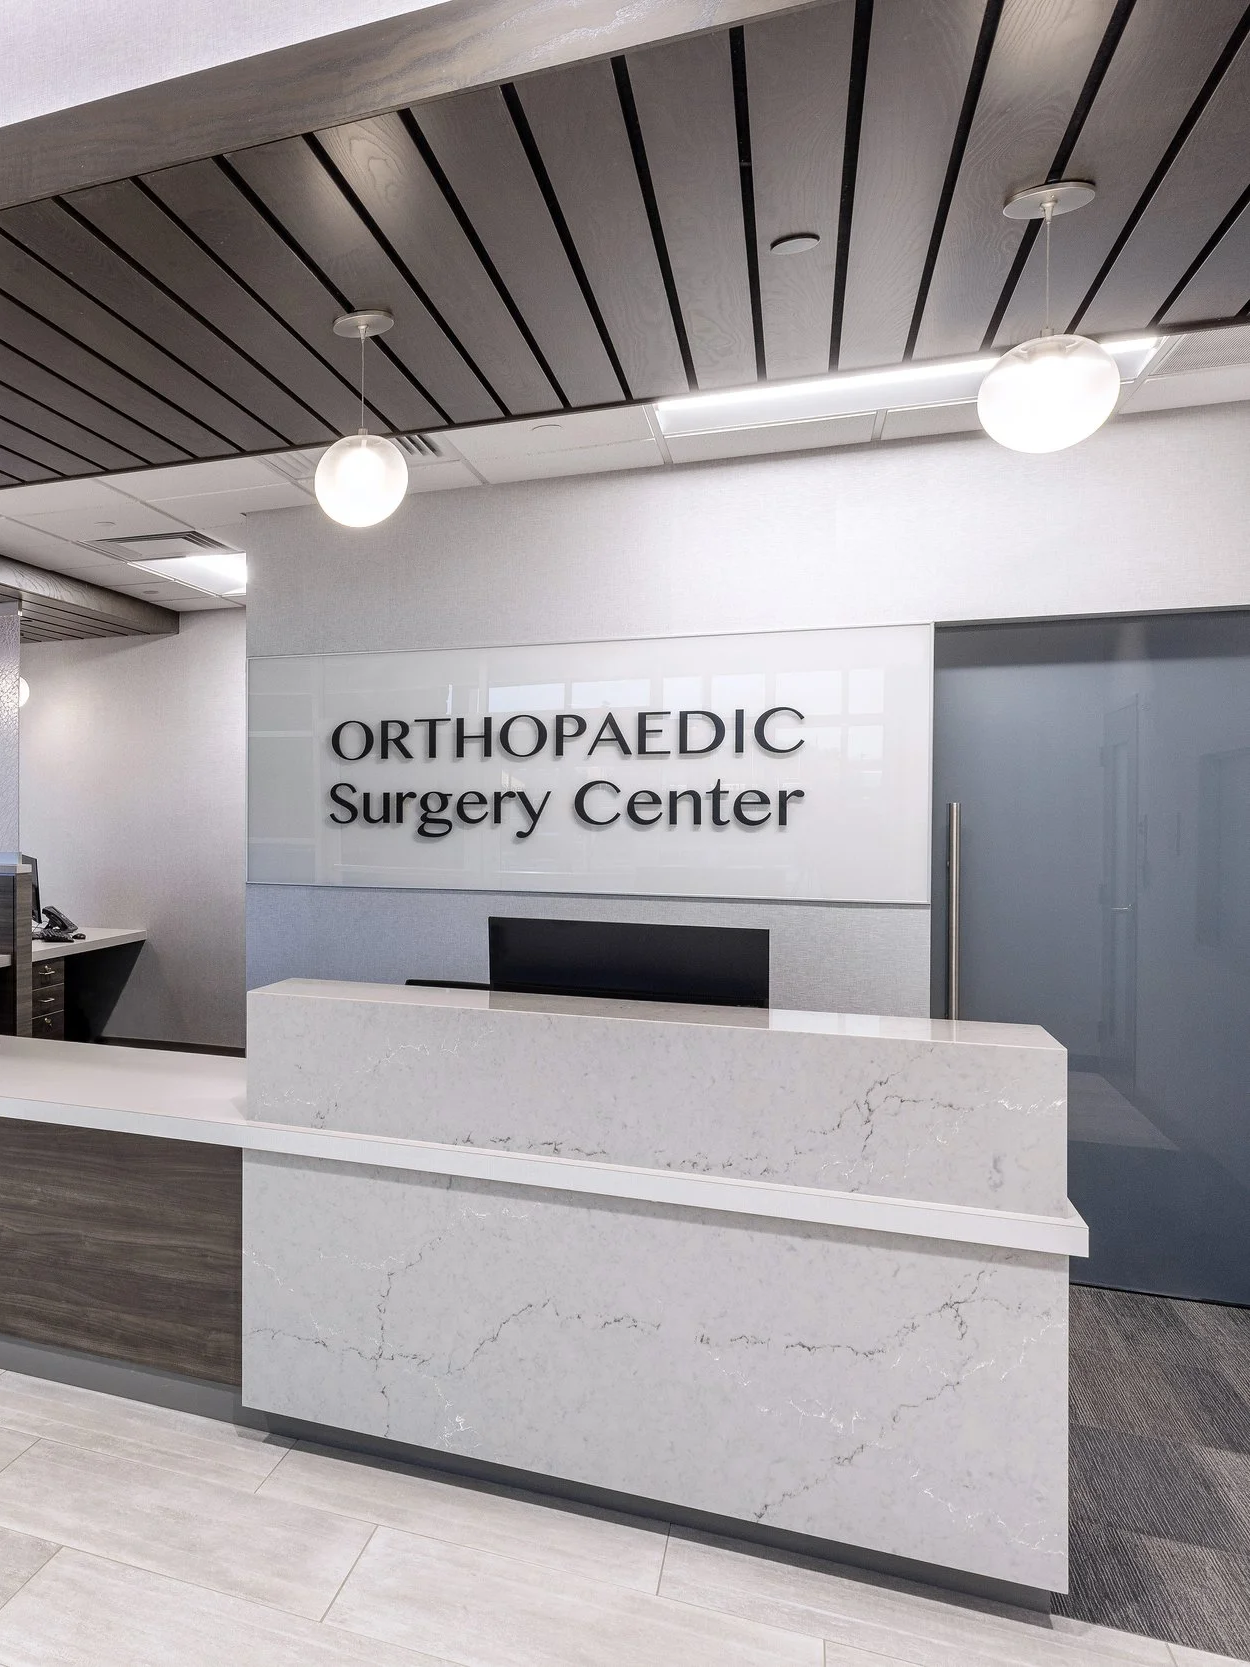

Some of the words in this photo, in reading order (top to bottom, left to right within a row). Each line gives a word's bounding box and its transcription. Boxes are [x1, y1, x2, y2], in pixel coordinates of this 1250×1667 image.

[331, 706, 805, 761] ORTHOPAEDIC
[329, 782, 552, 839] Surgery
[573, 778, 805, 827] Center
